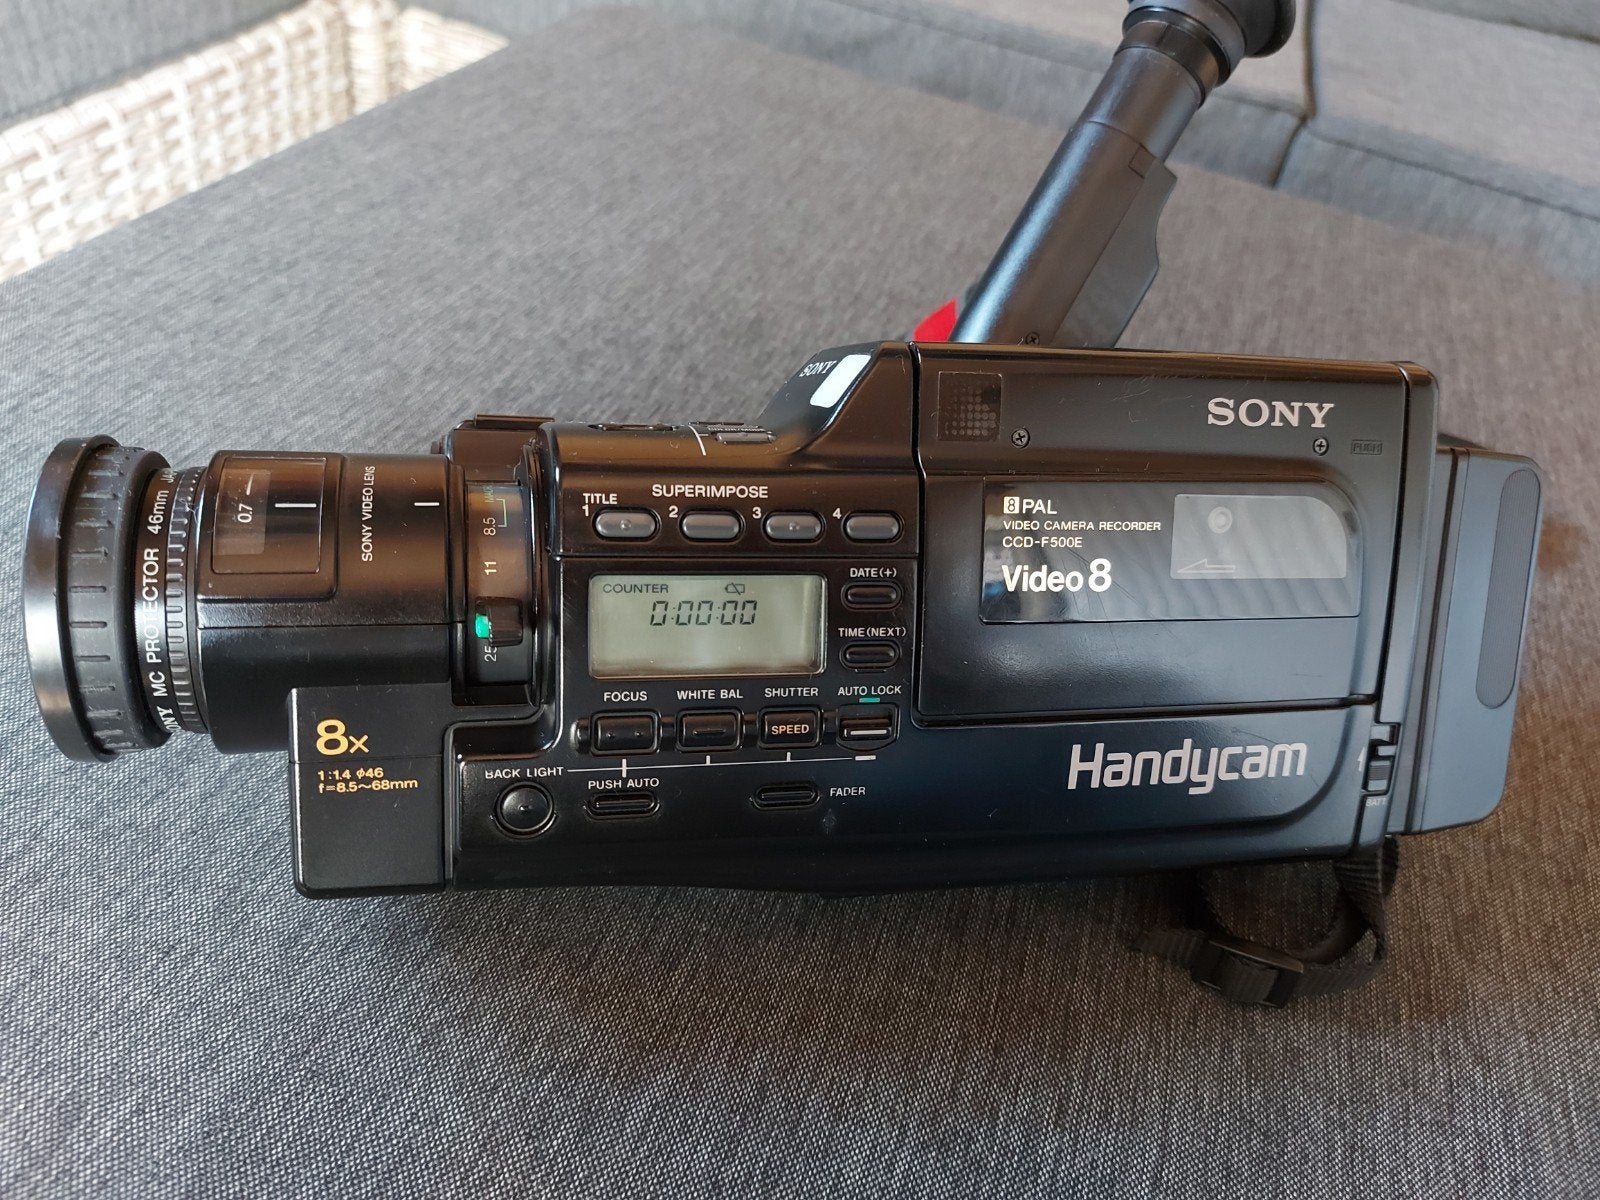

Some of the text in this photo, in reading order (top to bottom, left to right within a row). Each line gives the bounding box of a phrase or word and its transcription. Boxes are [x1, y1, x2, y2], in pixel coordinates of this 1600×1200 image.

[799, 360, 838, 377] SONY
[1207, 398, 1335, 428] SONY
[652, 484, 769, 499] SUPERIMPOSE
[583, 493, 618, 505] TITLE
[147, 490, 170, 534] 46mm
[237, 503, 253, 523] 0.7
[582, 505, 590, 517] 1
[669, 506, 679, 518] 2
[752, 507, 762, 519] 3
[1022, 499, 1058, 514] PAL
[361, 466, 376, 562] SONY VIDEO LENS
[832, 508, 842, 520] 4
[482, 517, 496, 536] 8.5
[1003, 520, 1162, 531] VIDEO CAMERA RECORDER
[1002, 536, 1083, 548] CCD-F500E
[484, 560, 498, 576] 11
[1001, 557, 1113, 593] Video 8
[602, 583, 669, 594] COUNTER
[142, 548, 163, 663] PROTECTOR
[650, 600, 758, 626] 0:00:00
[837, 627, 907, 638] TIME(NEXT)
[148, 671, 169, 697] MC
[837, 685, 902, 696] AUTO LOCK
[603, 691, 648, 702] FOCUS
[676, 689, 744, 701] WHITE BAL
[764, 687, 819, 698] SHUTTER
[157, 706, 182, 731] ONY
[771, 724, 810, 736] SPEED
[485, 766, 565, 780] BACK LIGHT
[1067, 738, 1308, 795] Handycam
[588, 777, 660, 790] PUSH AUTO
[829, 786, 867, 797] FADER
